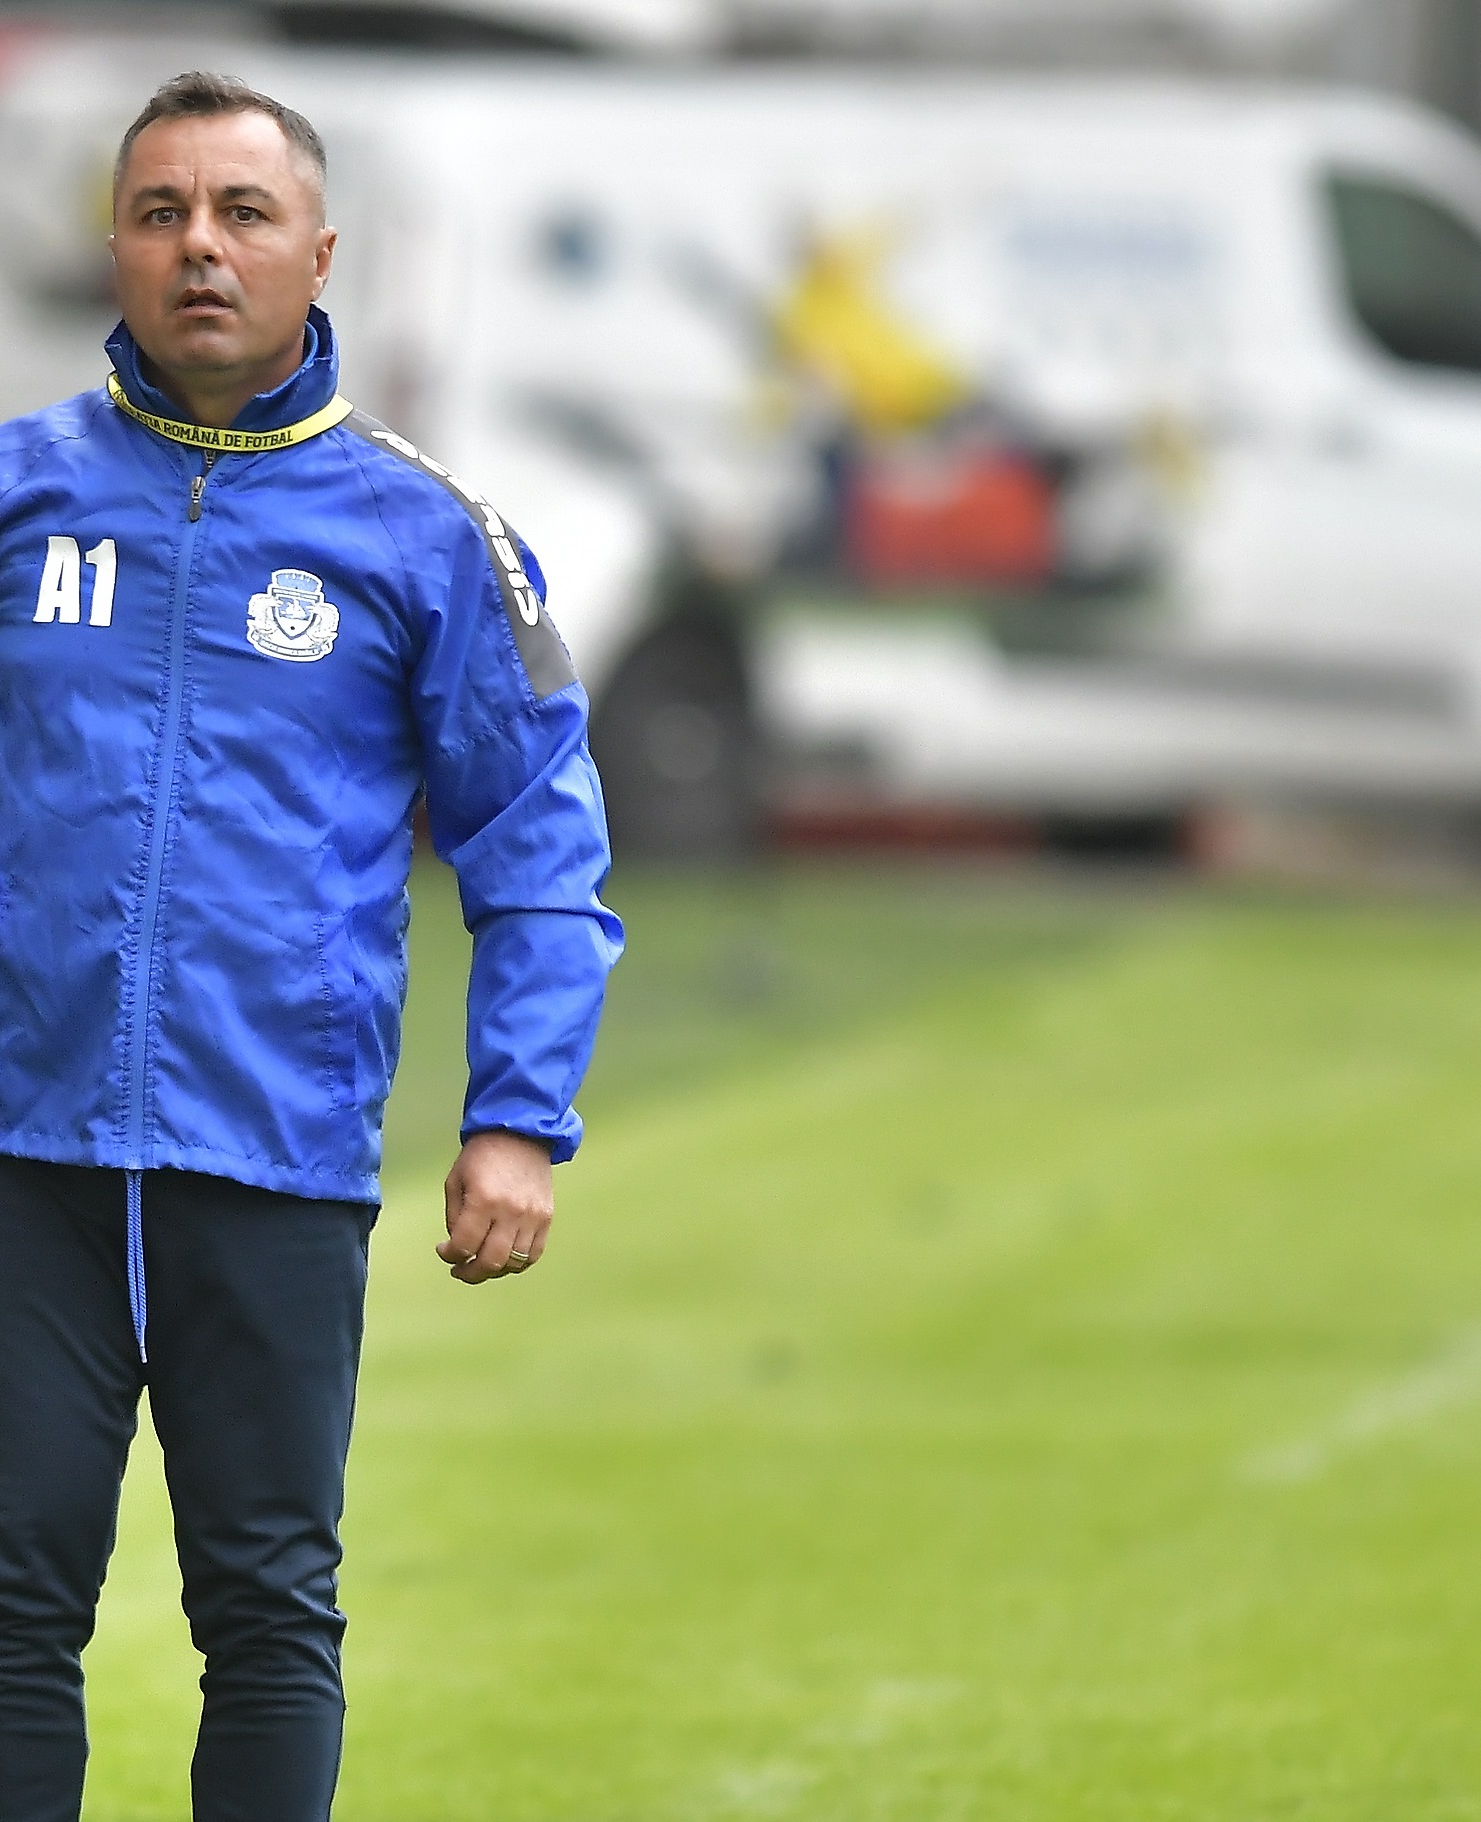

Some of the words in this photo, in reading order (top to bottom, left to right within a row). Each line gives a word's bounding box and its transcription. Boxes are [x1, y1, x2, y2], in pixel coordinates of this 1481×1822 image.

[224, 433, 242, 447] DE
[244, 430, 294, 448] FOTBAL
[32, 535, 117, 628] A1
